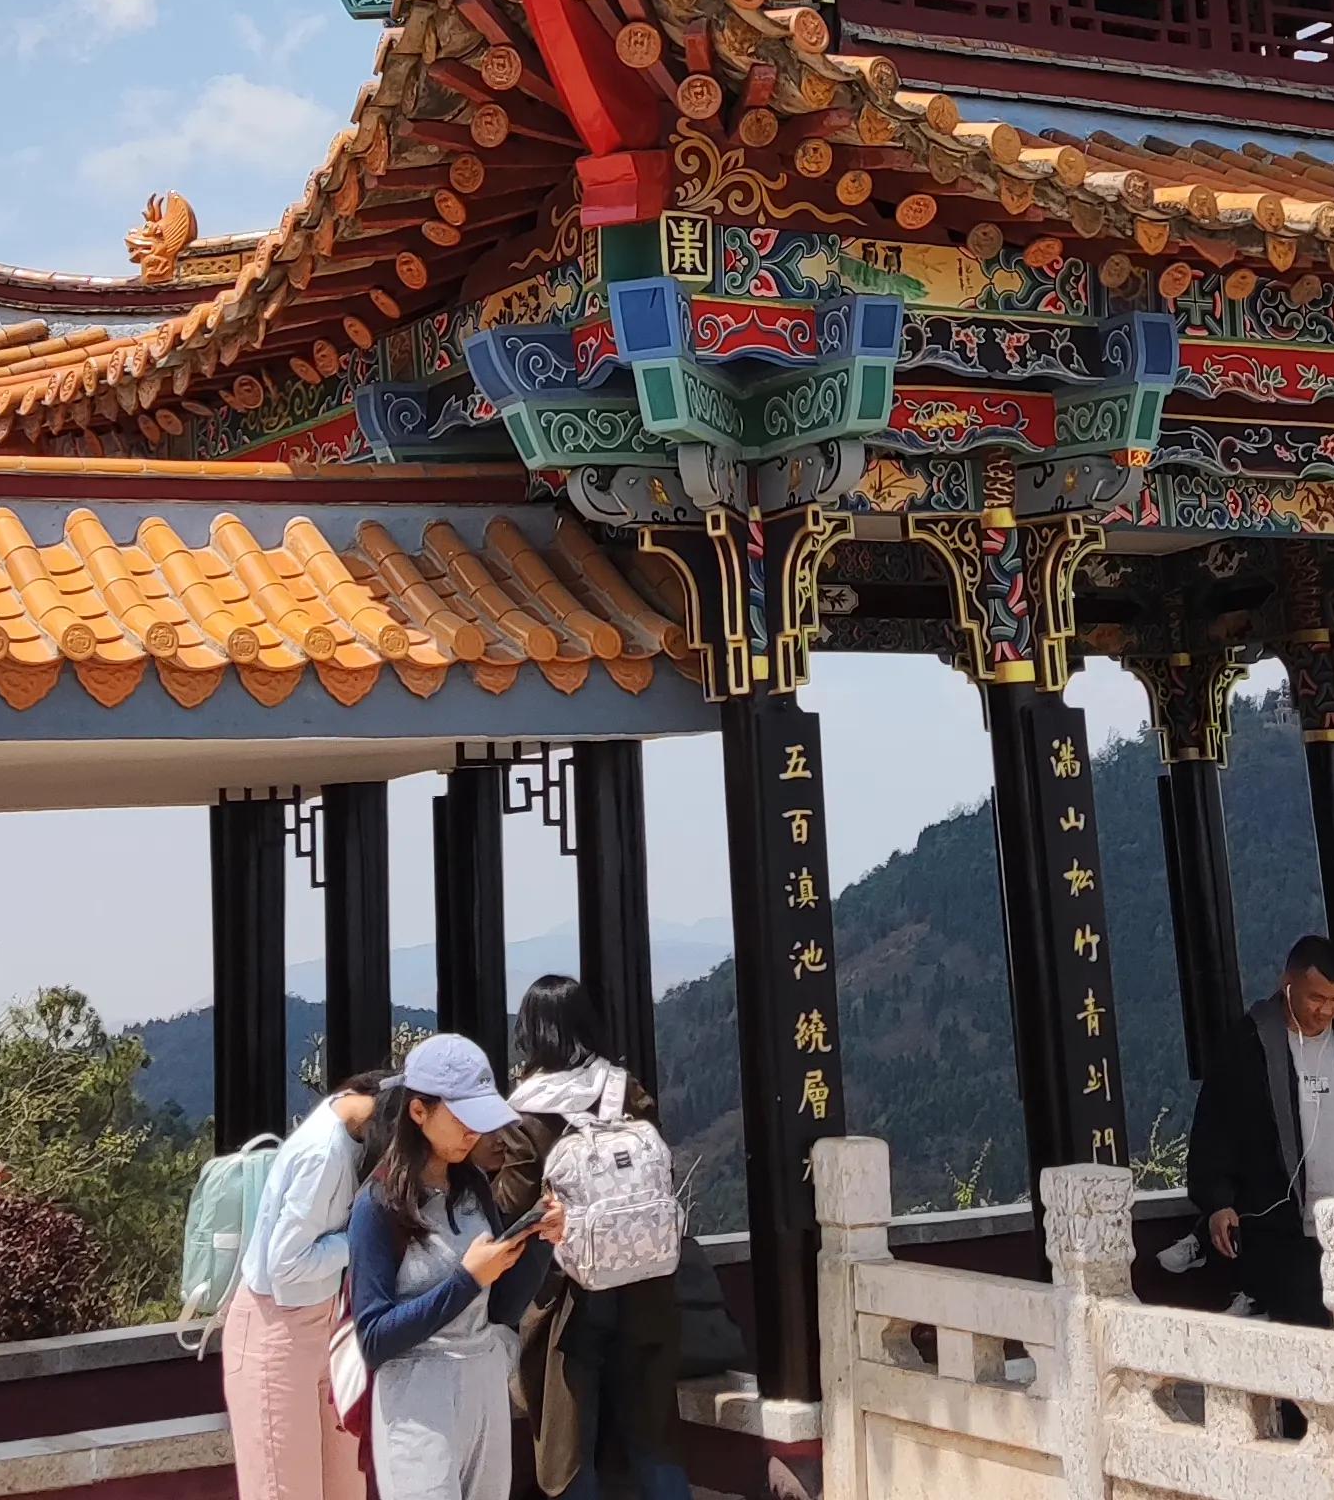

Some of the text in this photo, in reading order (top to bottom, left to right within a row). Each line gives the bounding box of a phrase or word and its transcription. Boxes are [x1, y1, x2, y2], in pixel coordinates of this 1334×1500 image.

[778, 743, 833, 1182] 五百滇池繞層
